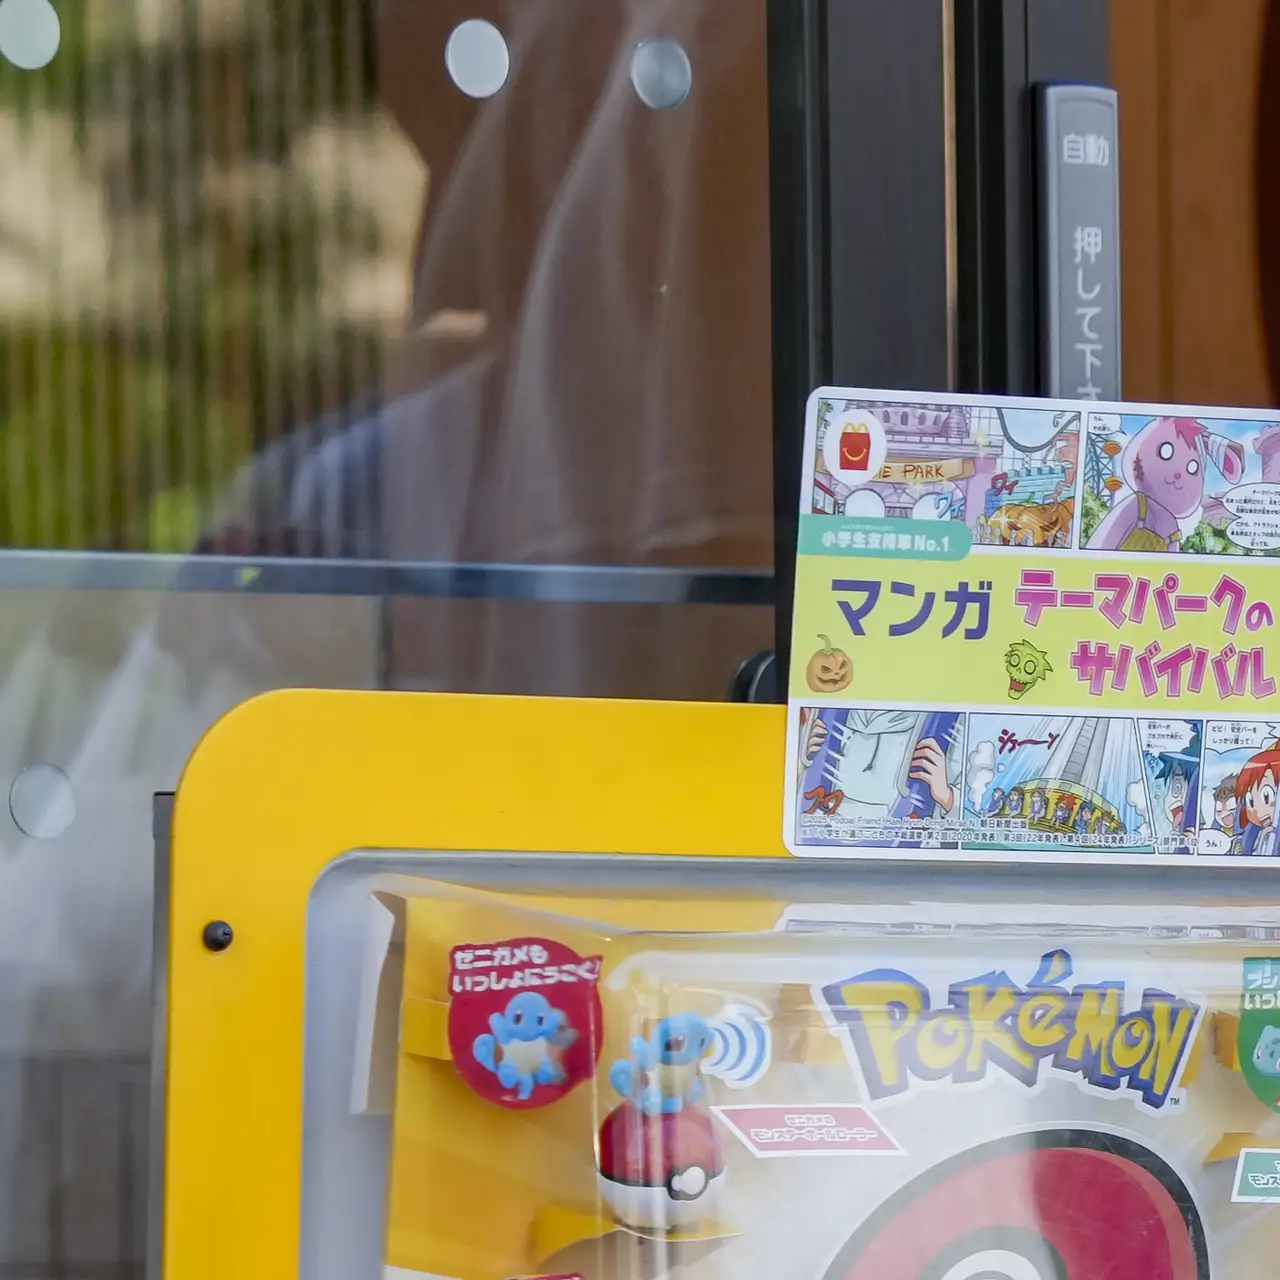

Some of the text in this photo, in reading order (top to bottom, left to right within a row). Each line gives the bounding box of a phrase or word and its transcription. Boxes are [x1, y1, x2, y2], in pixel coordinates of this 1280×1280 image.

[1062, 133, 1109, 166] 自動
[903, 464, 945, 479] PARK
[831, 578, 993, 640] マンガ
[1014, 568, 1275, 635] テーマパークの
[1071, 640, 1277, 700] サバイバル
[454, 944, 548, 970] ゼニガメも
